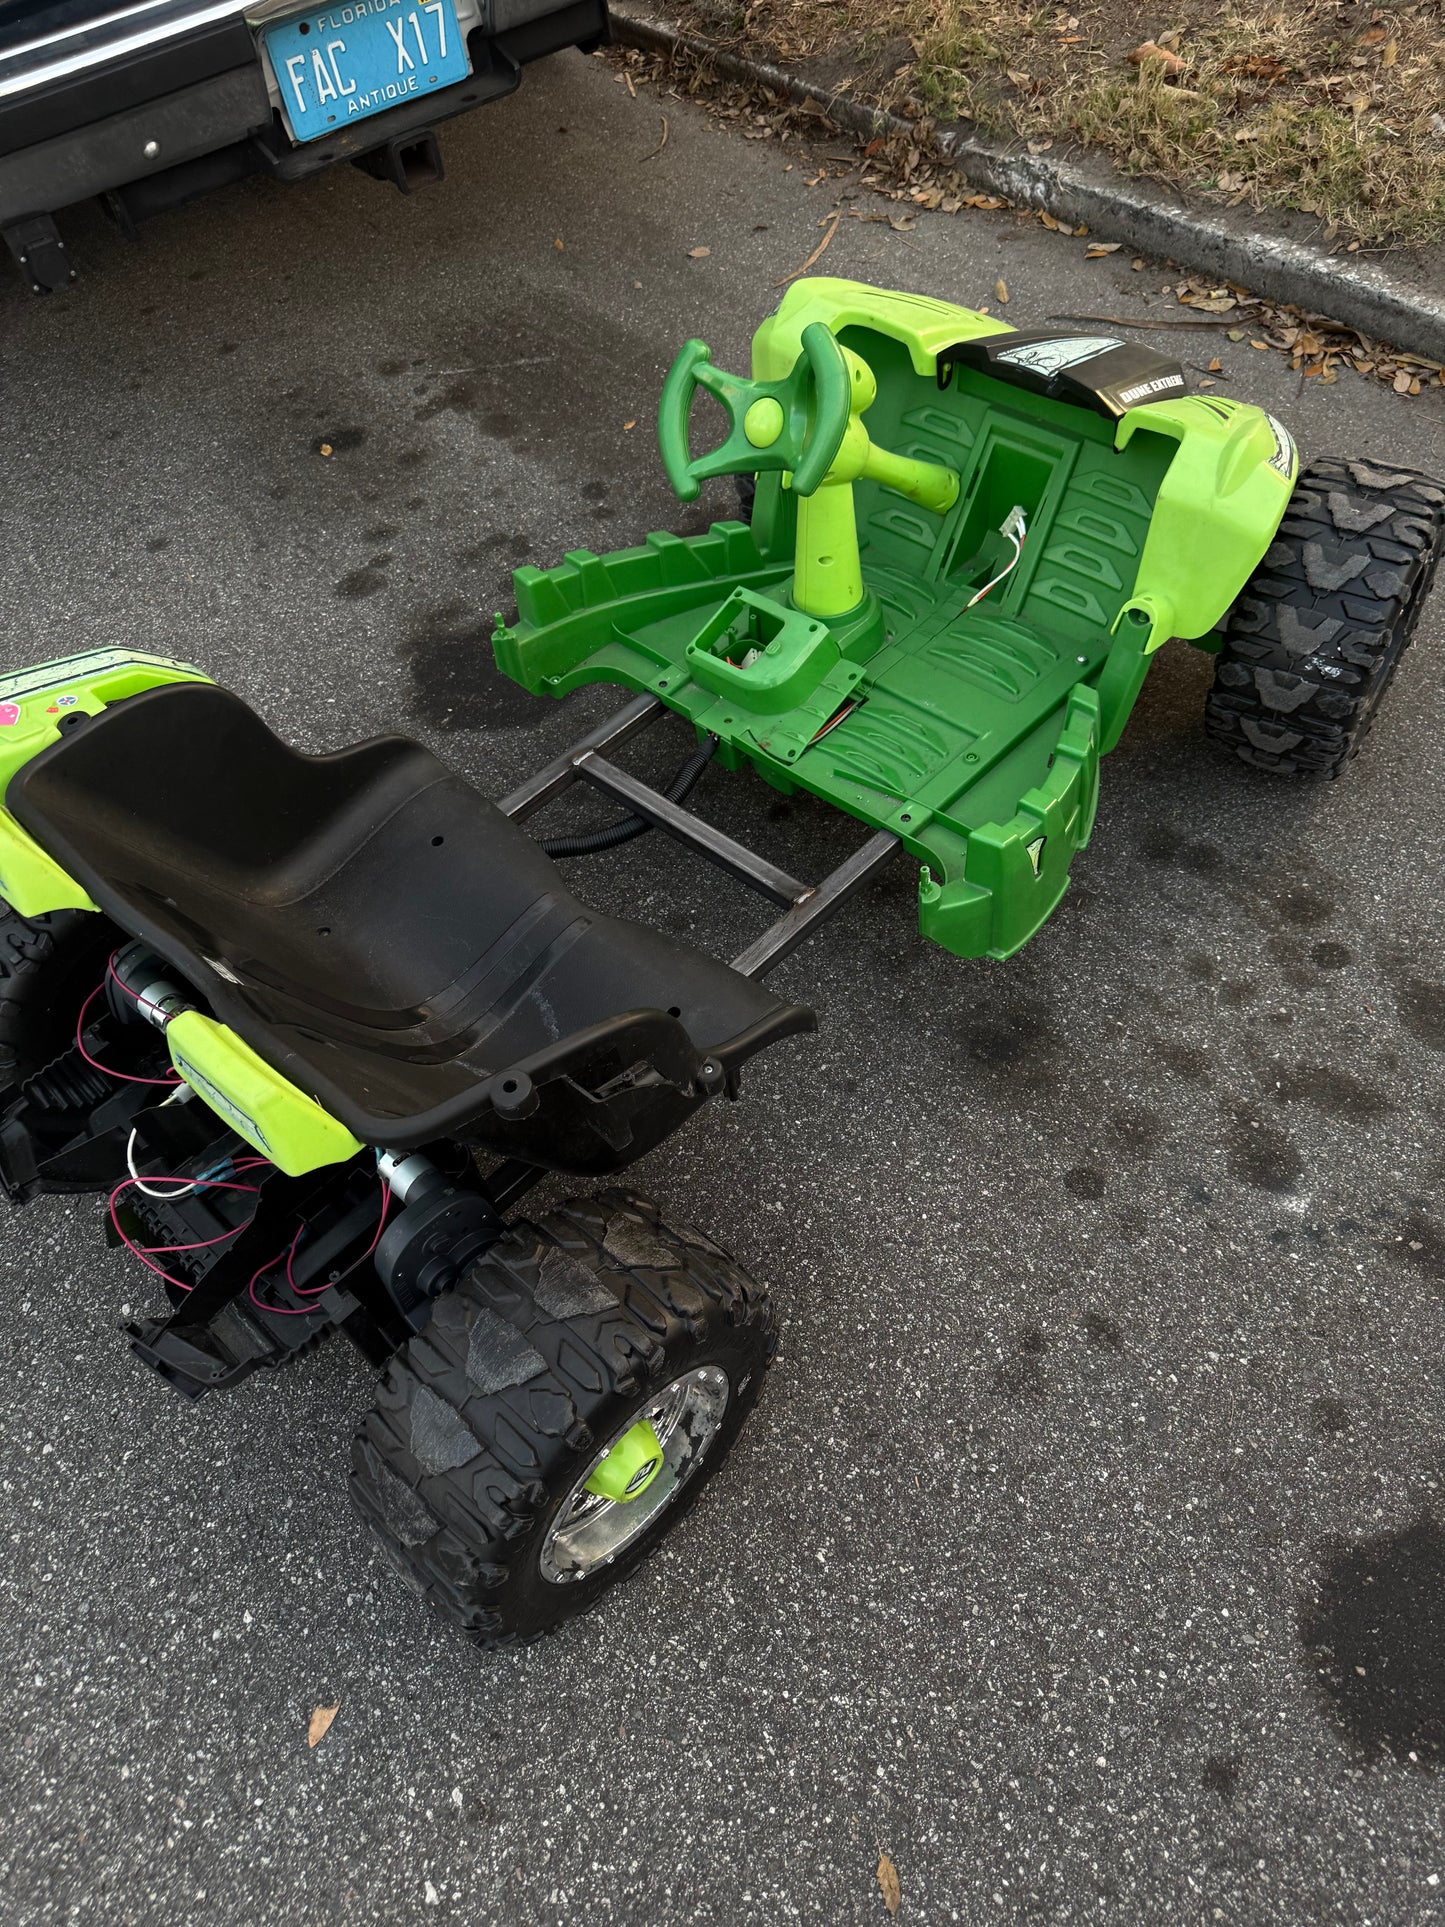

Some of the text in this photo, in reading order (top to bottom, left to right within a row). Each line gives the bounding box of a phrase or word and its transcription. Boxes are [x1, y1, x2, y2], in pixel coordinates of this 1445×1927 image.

[285, 2, 447, 113] FAC X17
[347, 75, 419, 115] ANTIQUE
[1119, 383, 1153, 404] DUNE
